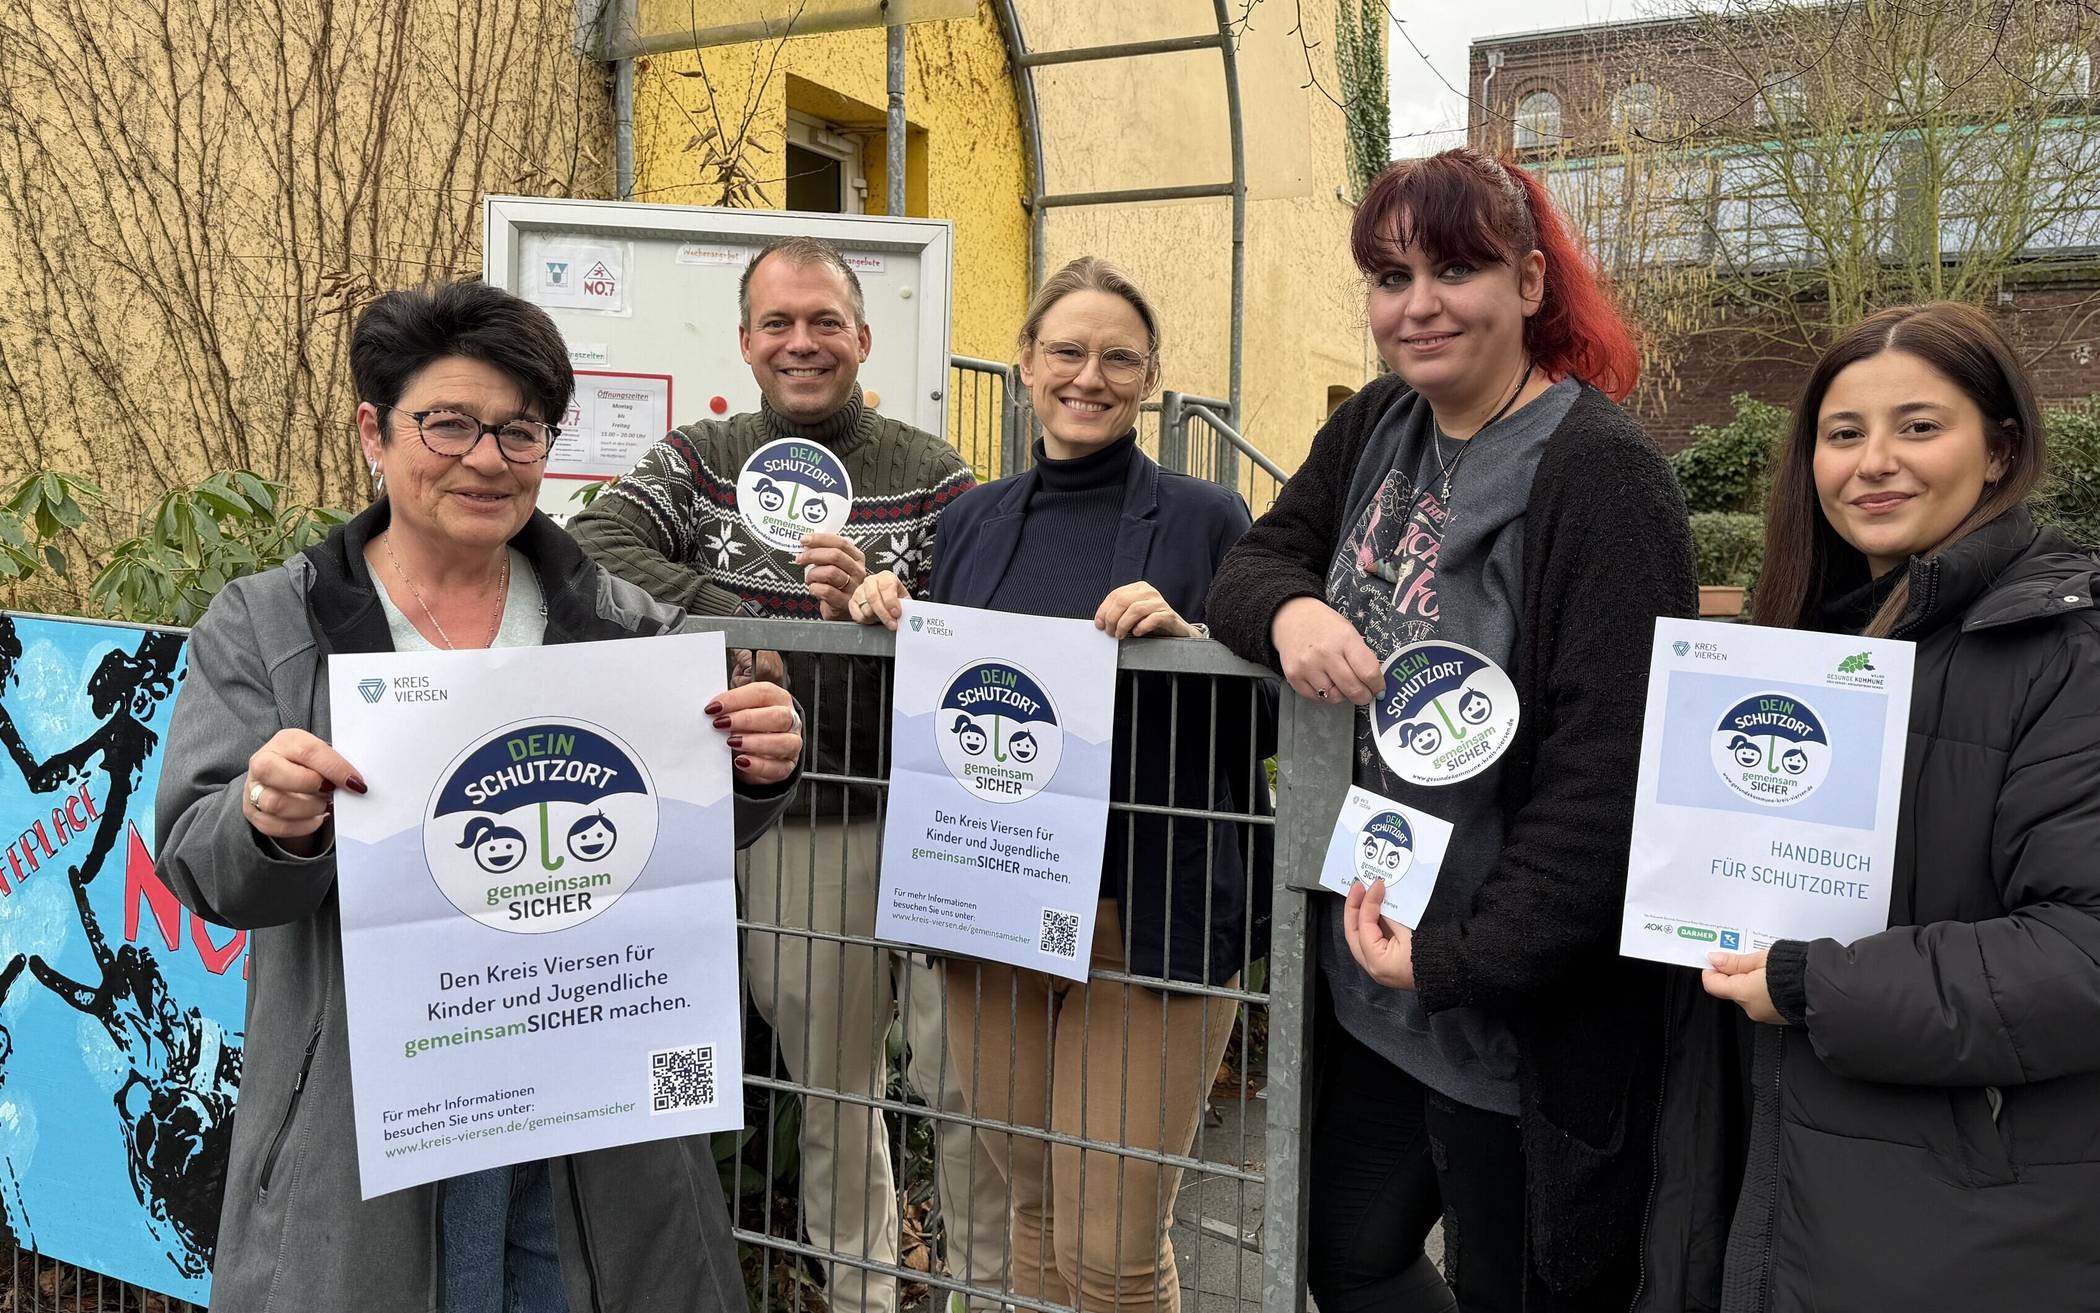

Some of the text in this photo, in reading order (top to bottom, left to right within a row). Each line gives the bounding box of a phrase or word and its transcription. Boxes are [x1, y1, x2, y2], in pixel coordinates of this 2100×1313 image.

[584, 281, 615, 296] NO.7
[570, 351, 605, 361] ngszeiten
[790, 446, 823, 466] DEIN
[763, 459, 838, 488] SCHUTZORT
[762, 514, 815, 534] gemeinsam
[927, 618, 945, 627] KREIS
[927, 627, 953, 637] VIERSEN
[1694, 642, 1718, 651] KREIS
[1694, 651, 1728, 661] VIERSEN
[981, 668, 1017, 688] DEIN
[1391, 652, 1430, 683] DEIN
[394, 676, 429, 689] KREIS
[1386, 661, 1464, 718] SCHUTZORT
[1855, 677, 1884, 686] KOMMUNE
[395, 689, 448, 702] VIERSEN
[957, 687, 1040, 716] SCHUTZORT
[1760, 699, 1795, 714] DEIN
[1735, 712, 1814, 737] SCHUTZORT
[507, 733, 575, 762] DEIN
[1432, 726, 1496, 769] gemeinsam
[1446, 740, 1491, 771] SICHER
[464, 759, 618, 805] SCHUTZORT
[964, 762, 1034, 782] gemeinsam
[1742, 772, 1798, 787] gemeinsam
[975, 776, 1022, 795] SICHER
[1751, 781, 1788, 796] SICHER
[935, 810, 1054, 842] Den Kreis Viersen für
[1386, 815, 1404, 826] DEIN
[0, 781, 104, 897] FEPLACE
[926, 828, 1060, 862] Kinder und Jugendliche
[1371, 824, 1408, 844] SCHUTZORT
[911, 847, 1071, 884] gemeinsamSICHER machen.
[1771, 841, 1871, 872] HANDBUCH
[1363, 870, 1386, 882] SICH
[1711, 858, 1870, 900] FÜR SCHUTZORTE
[486, 871, 612, 906] gemeinsam
[894, 888, 977, 910] Für mehr Informationen
[508, 892, 592, 921] SICHER
[893, 900, 976, 922] besuchen Sie uns unter:
[1644, 923, 1663, 932] AOK
[440, 945, 655, 991] Den Kreis Viersen für
[428, 970, 669, 1022] Kinder und Jugendliche
[404, 993, 691, 1058] gemeinsamSICHER machen.
[383, 1085, 535, 1124] Für mehr Informationen
[384, 1103, 535, 1142] besuchen Sie uns unter:
[385, 1101, 636, 1159] www.kreis-viersen.de/gemeinsamsicher
